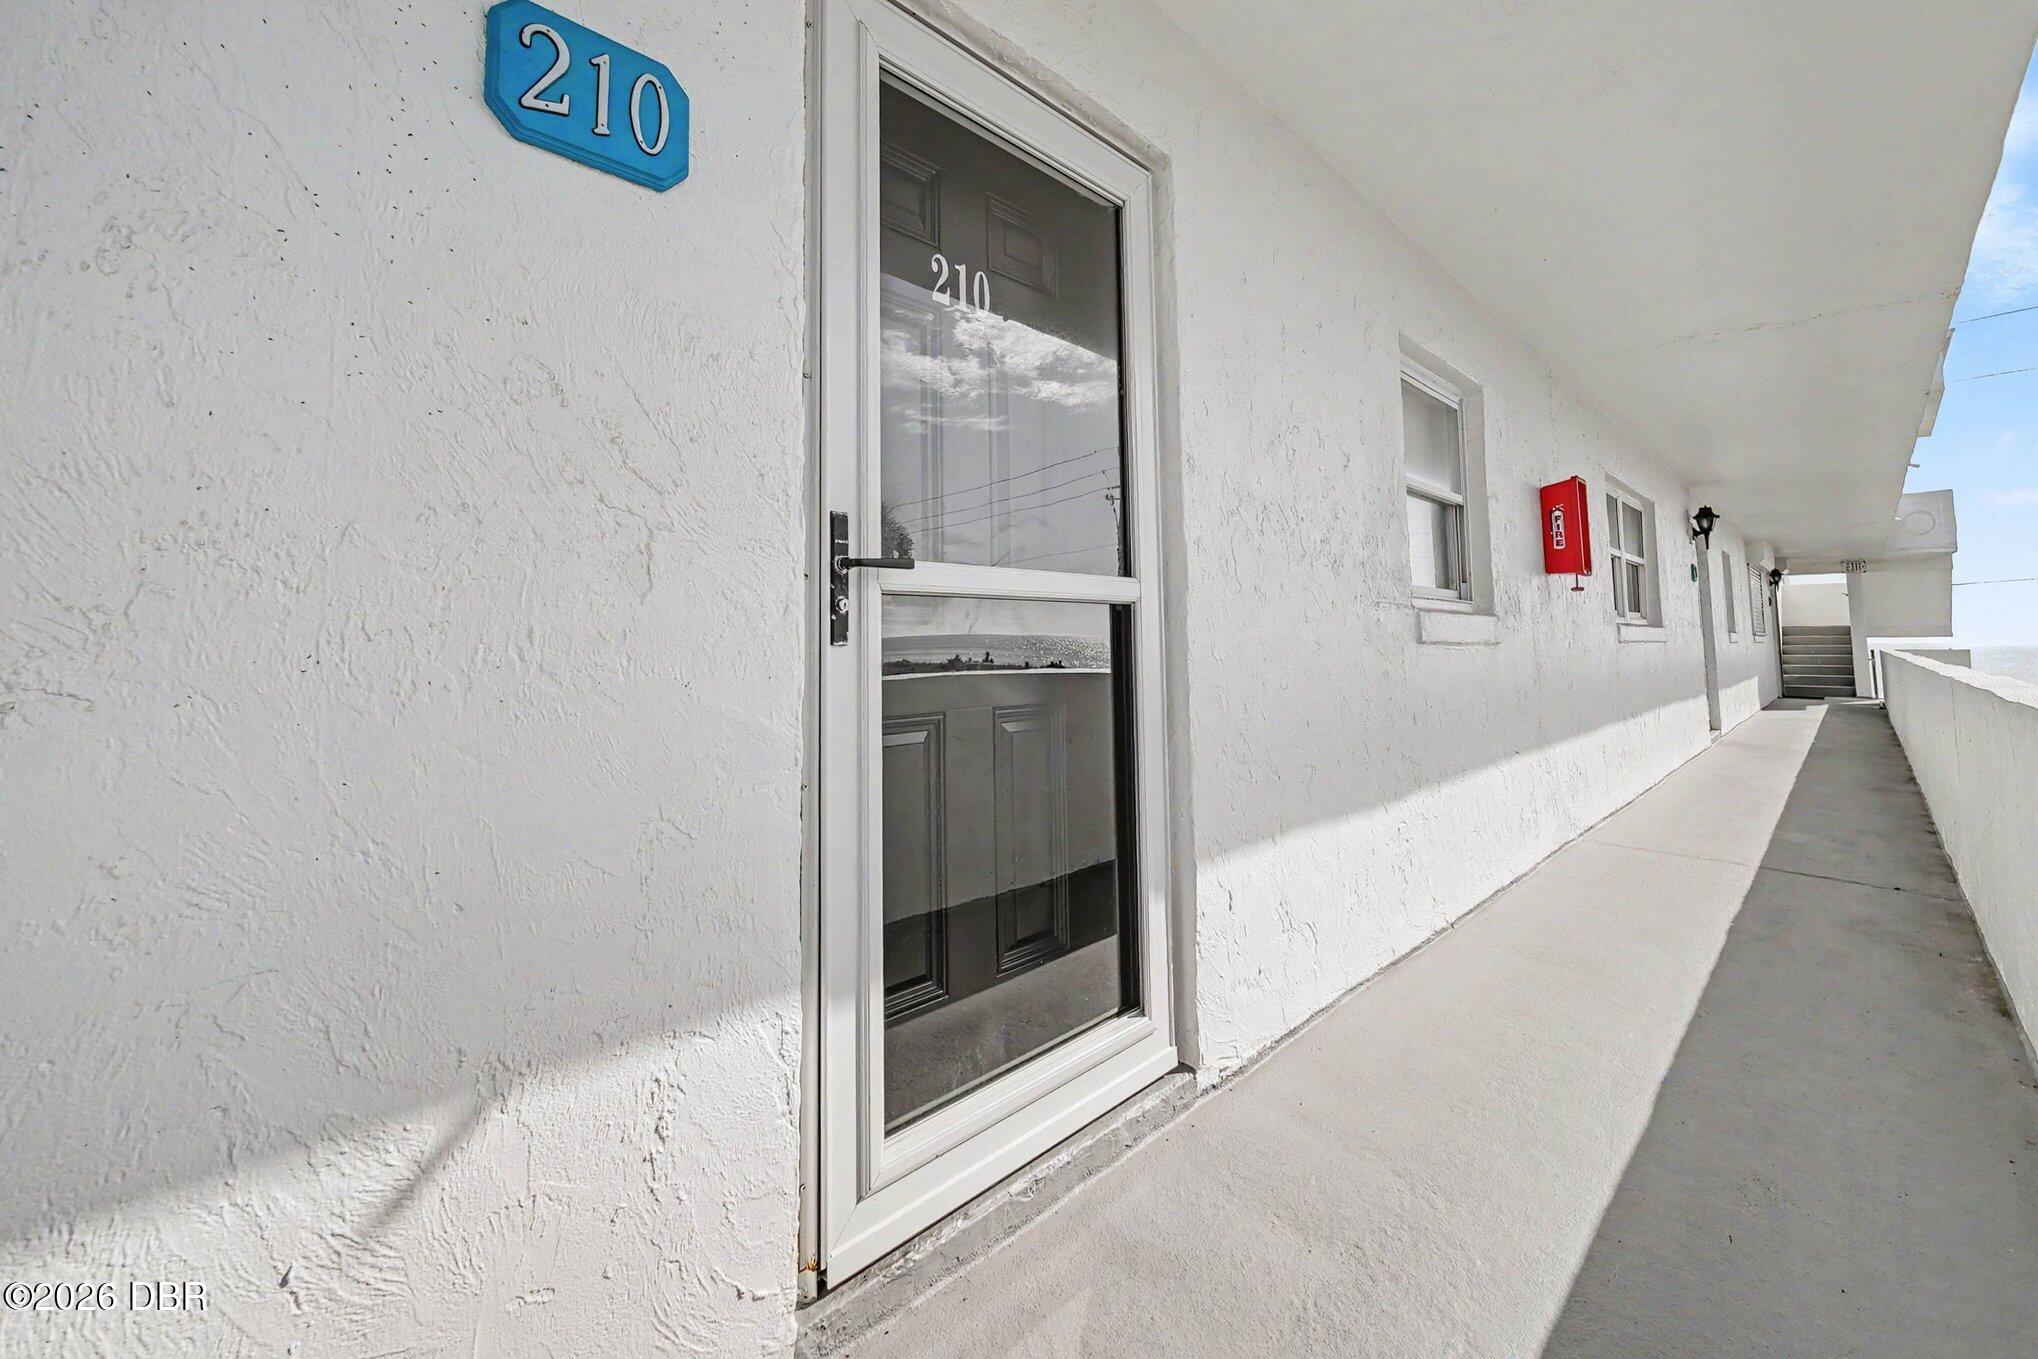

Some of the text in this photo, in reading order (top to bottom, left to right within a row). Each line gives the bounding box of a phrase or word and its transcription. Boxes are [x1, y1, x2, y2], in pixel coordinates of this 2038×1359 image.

[519, 23, 669, 156] 210
[931, 253, 990, 315] 210
[1554, 515, 1564, 547] FIRE
